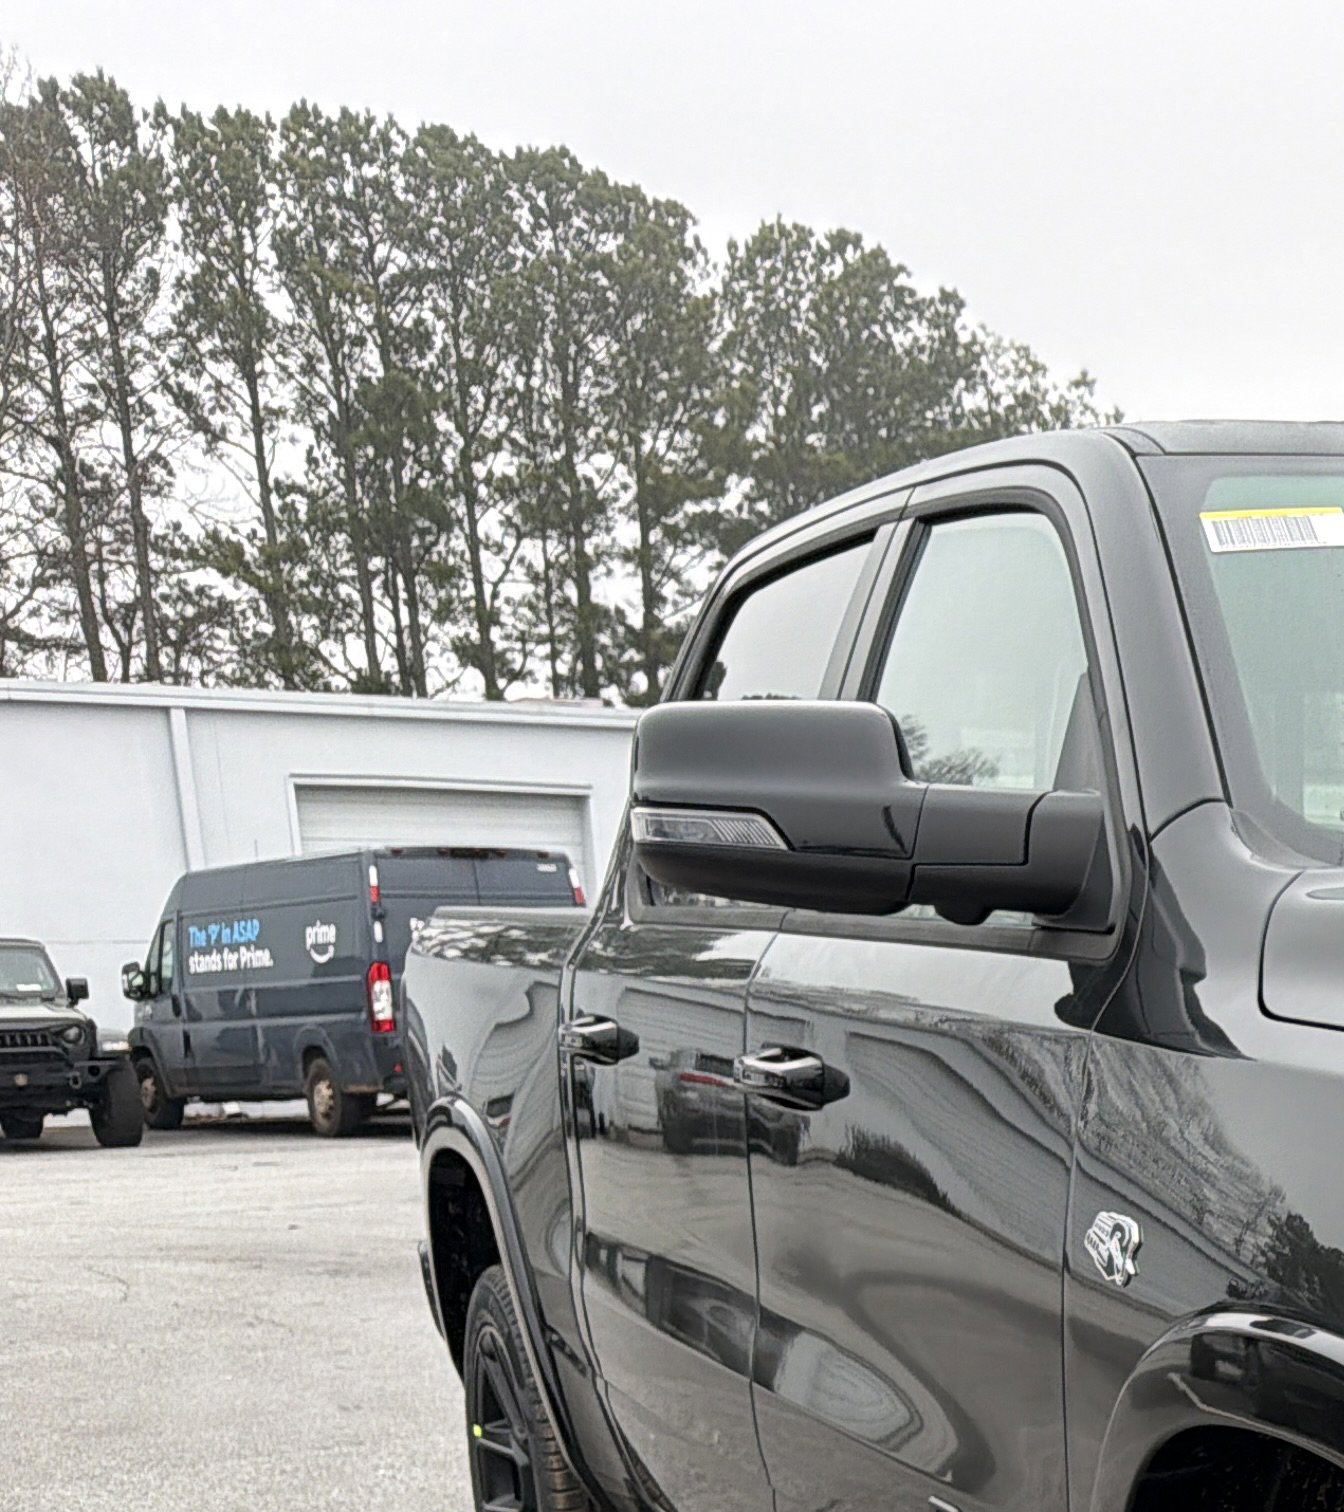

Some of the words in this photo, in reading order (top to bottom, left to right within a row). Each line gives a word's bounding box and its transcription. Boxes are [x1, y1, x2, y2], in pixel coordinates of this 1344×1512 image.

[188, 925, 206, 948] The
[221, 921, 231, 945] in
[232, 918, 260, 944] ASAP
[305, 919, 336, 951] prime
[188, 948, 222, 975] stands
[223, 947, 239, 971] for
[239, 943, 274, 969] Prime.
